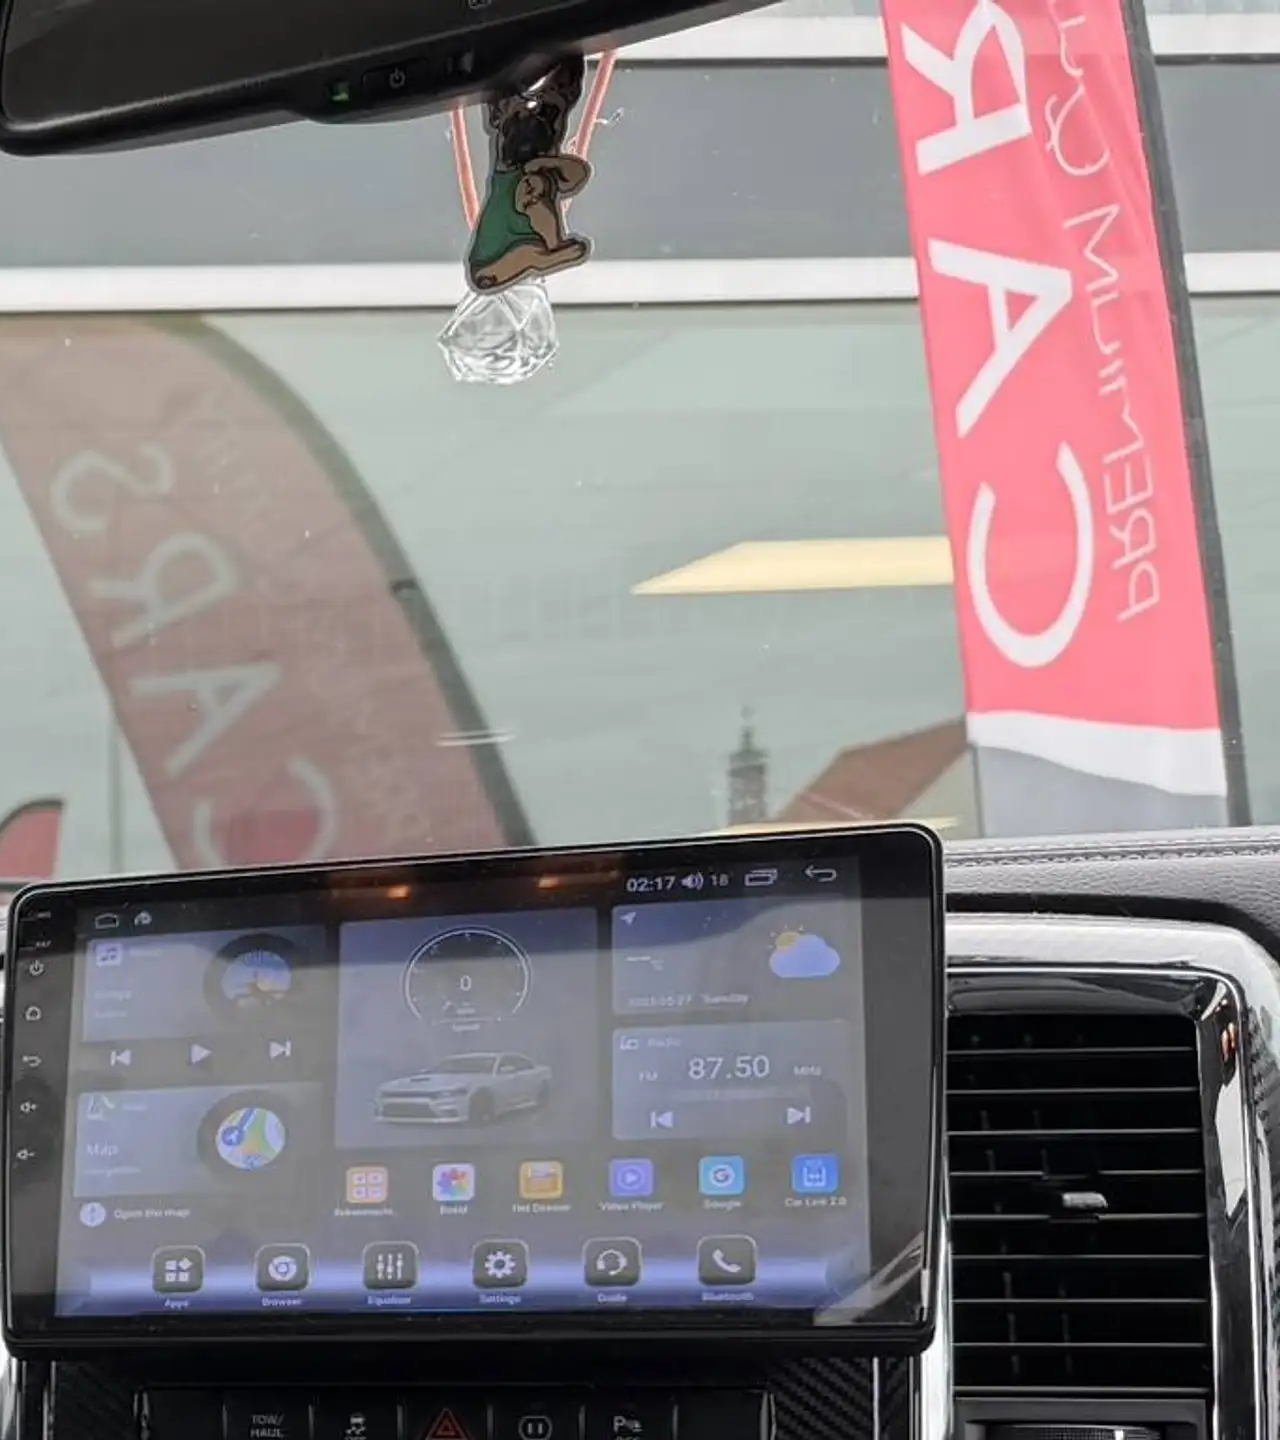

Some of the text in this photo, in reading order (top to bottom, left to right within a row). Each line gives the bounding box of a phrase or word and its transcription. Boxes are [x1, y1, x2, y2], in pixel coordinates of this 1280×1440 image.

[626, 874, 676, 893] 02:17
[687, 1055, 771, 1081] 87.50
[85, 1142, 119, 1159] Map
[164, 1298, 189, 1309] Apps
[478, 1292, 522, 1305] Settings
